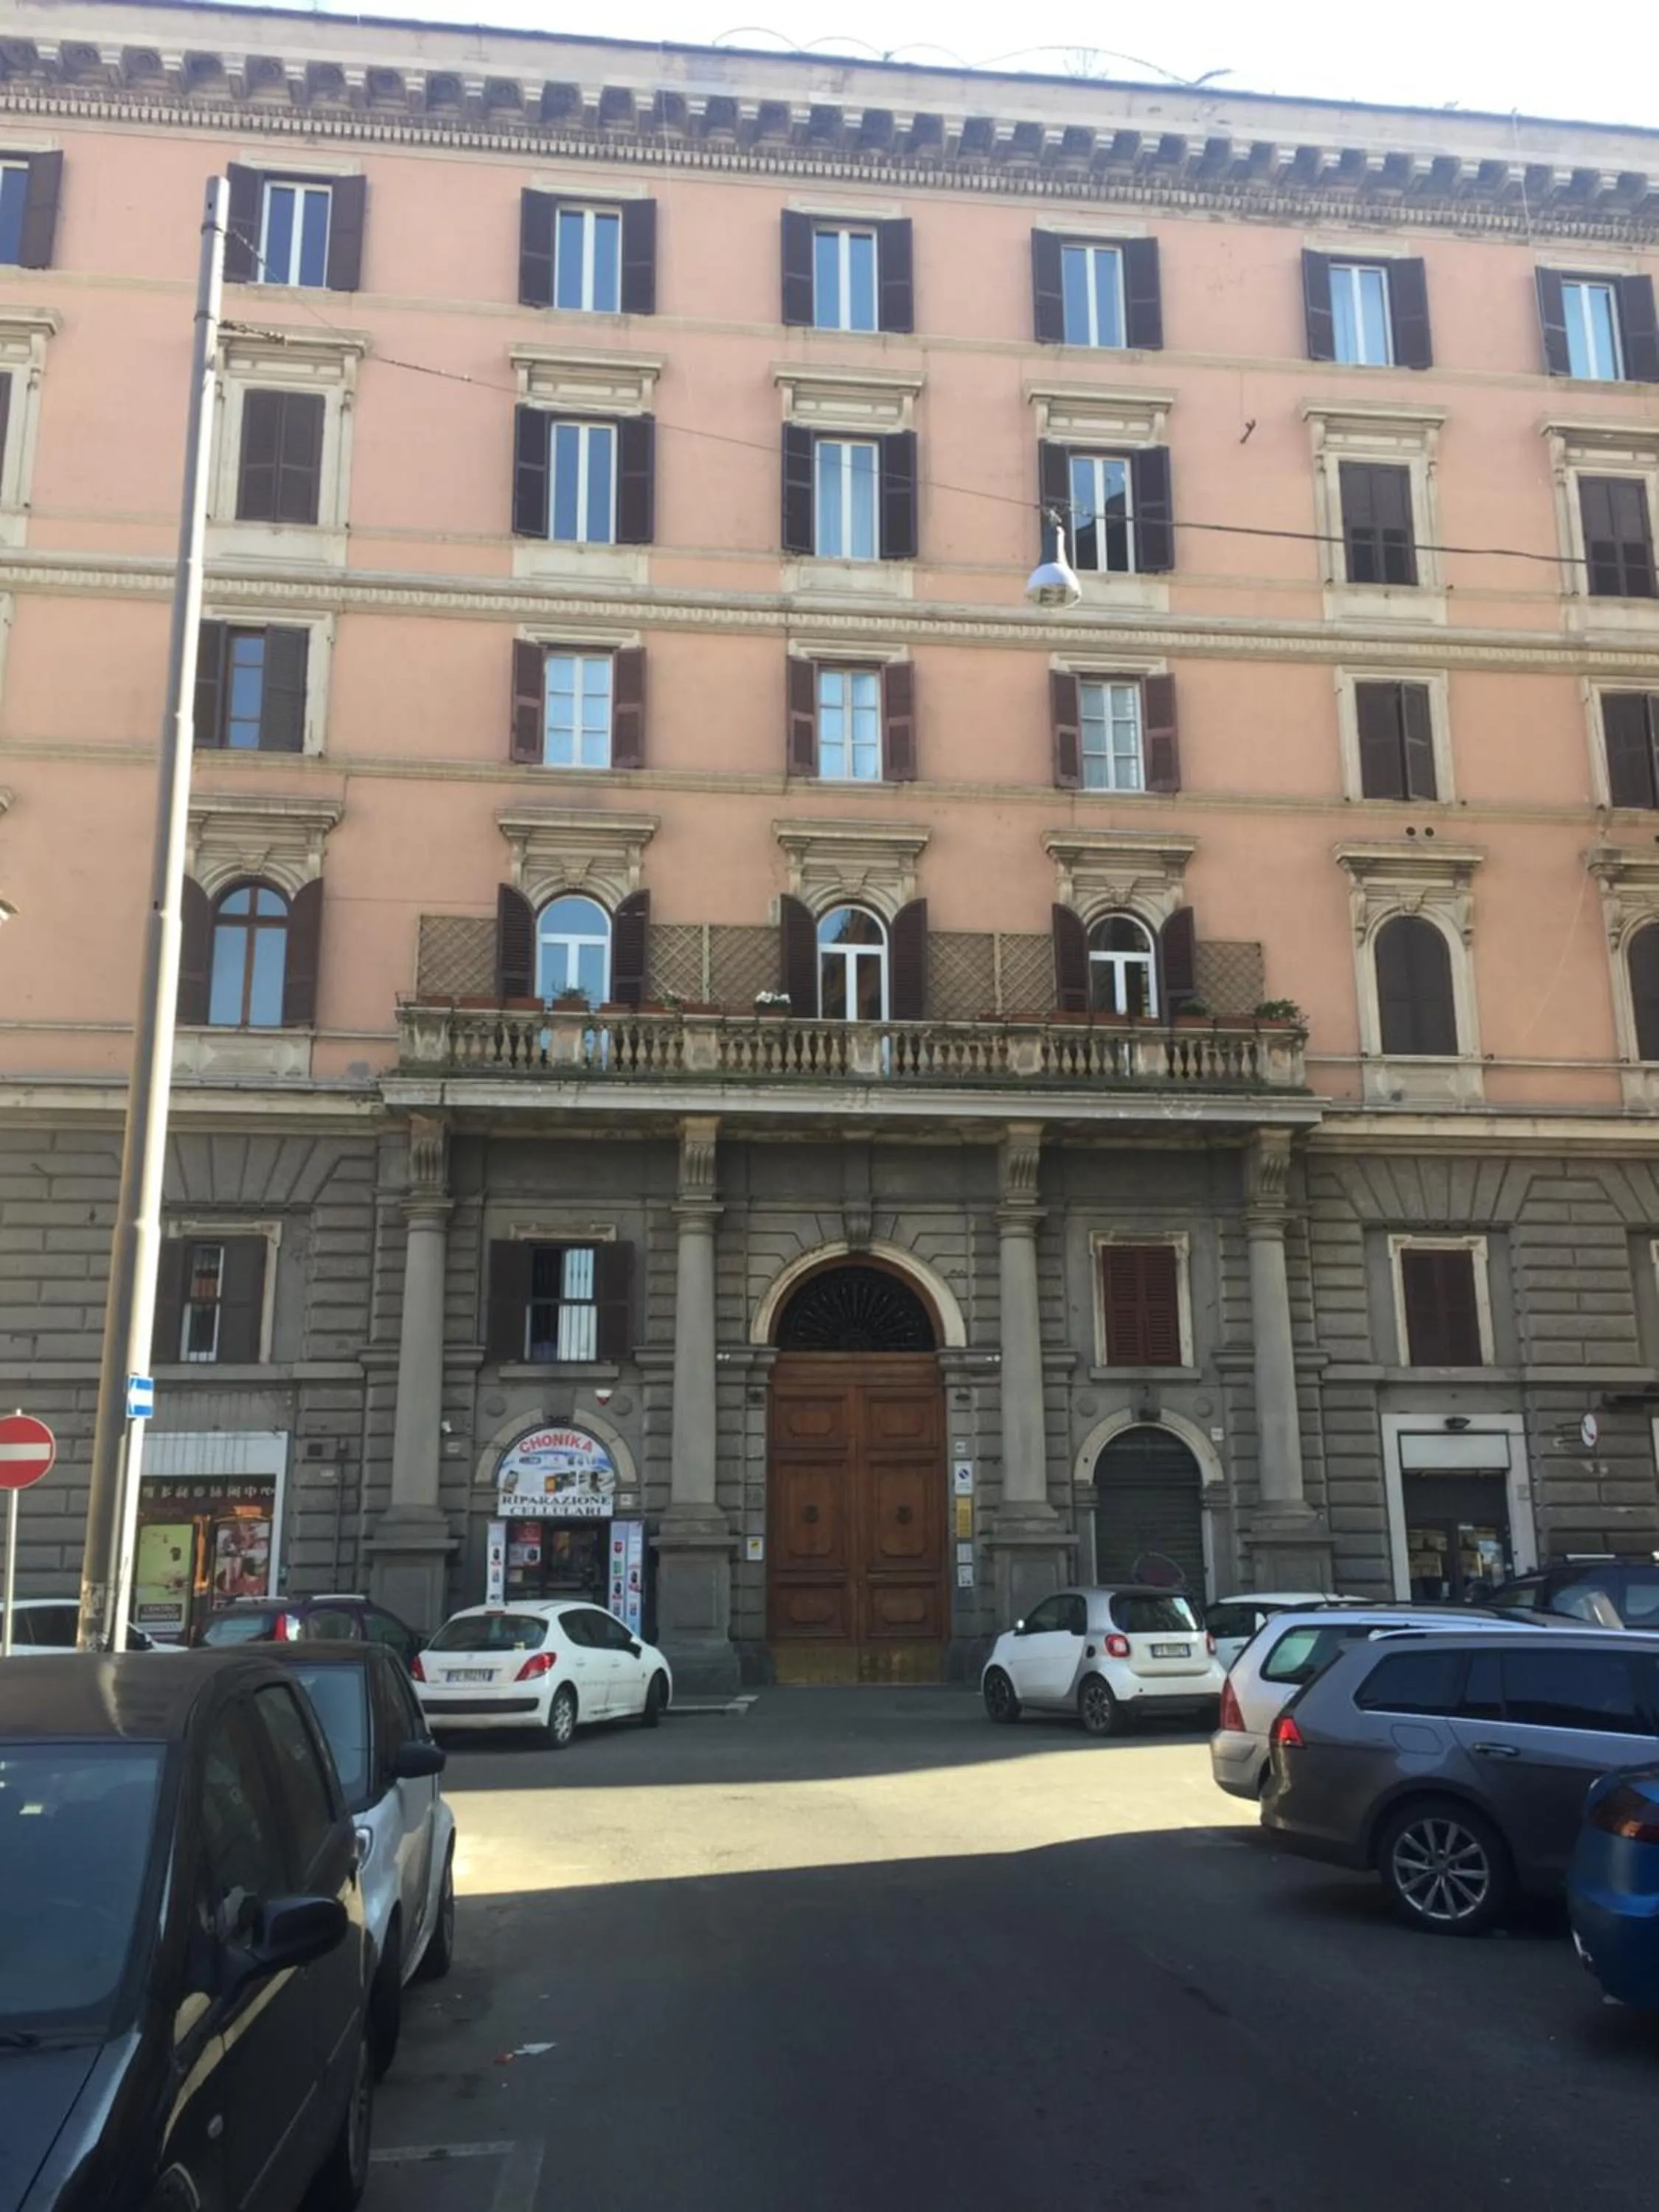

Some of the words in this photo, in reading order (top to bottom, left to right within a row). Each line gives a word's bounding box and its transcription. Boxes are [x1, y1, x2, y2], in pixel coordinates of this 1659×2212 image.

[519, 1433, 594, 1453] CHONIKA
[501, 1495, 611, 1505] RIPARAZIONE
[509, 1506, 602, 1516] CELLULARI
